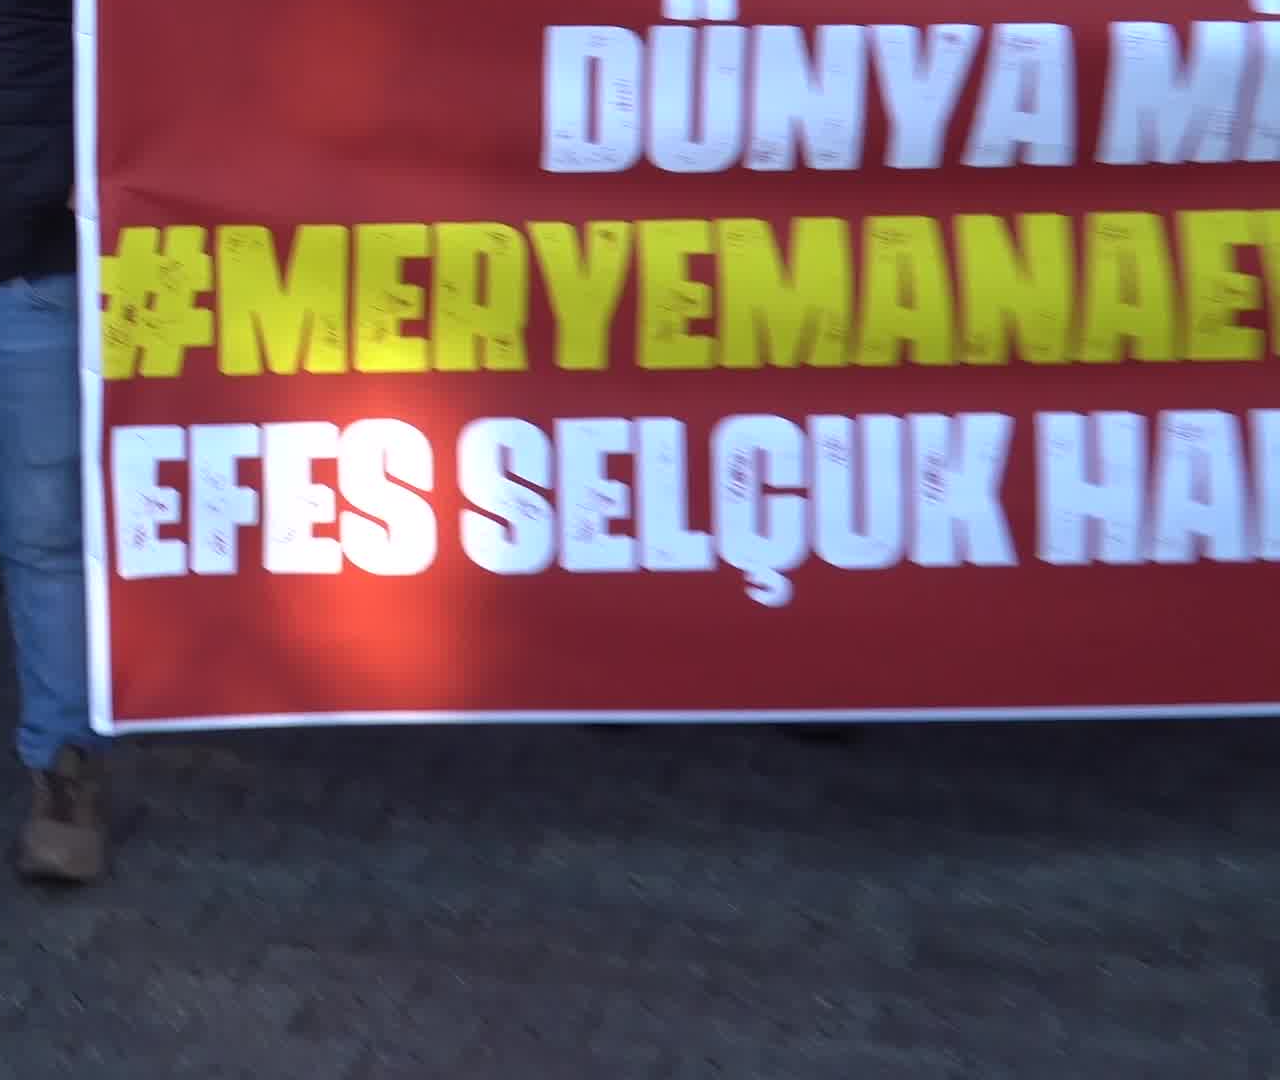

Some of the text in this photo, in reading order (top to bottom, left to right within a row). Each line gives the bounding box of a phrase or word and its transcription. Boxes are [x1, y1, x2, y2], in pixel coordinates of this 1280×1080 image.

[100, 209, 1280, 380] #MERYEMANAE
[110, 416, 438, 580] EFES
[456, 412, 1019, 607] SELÇUK
